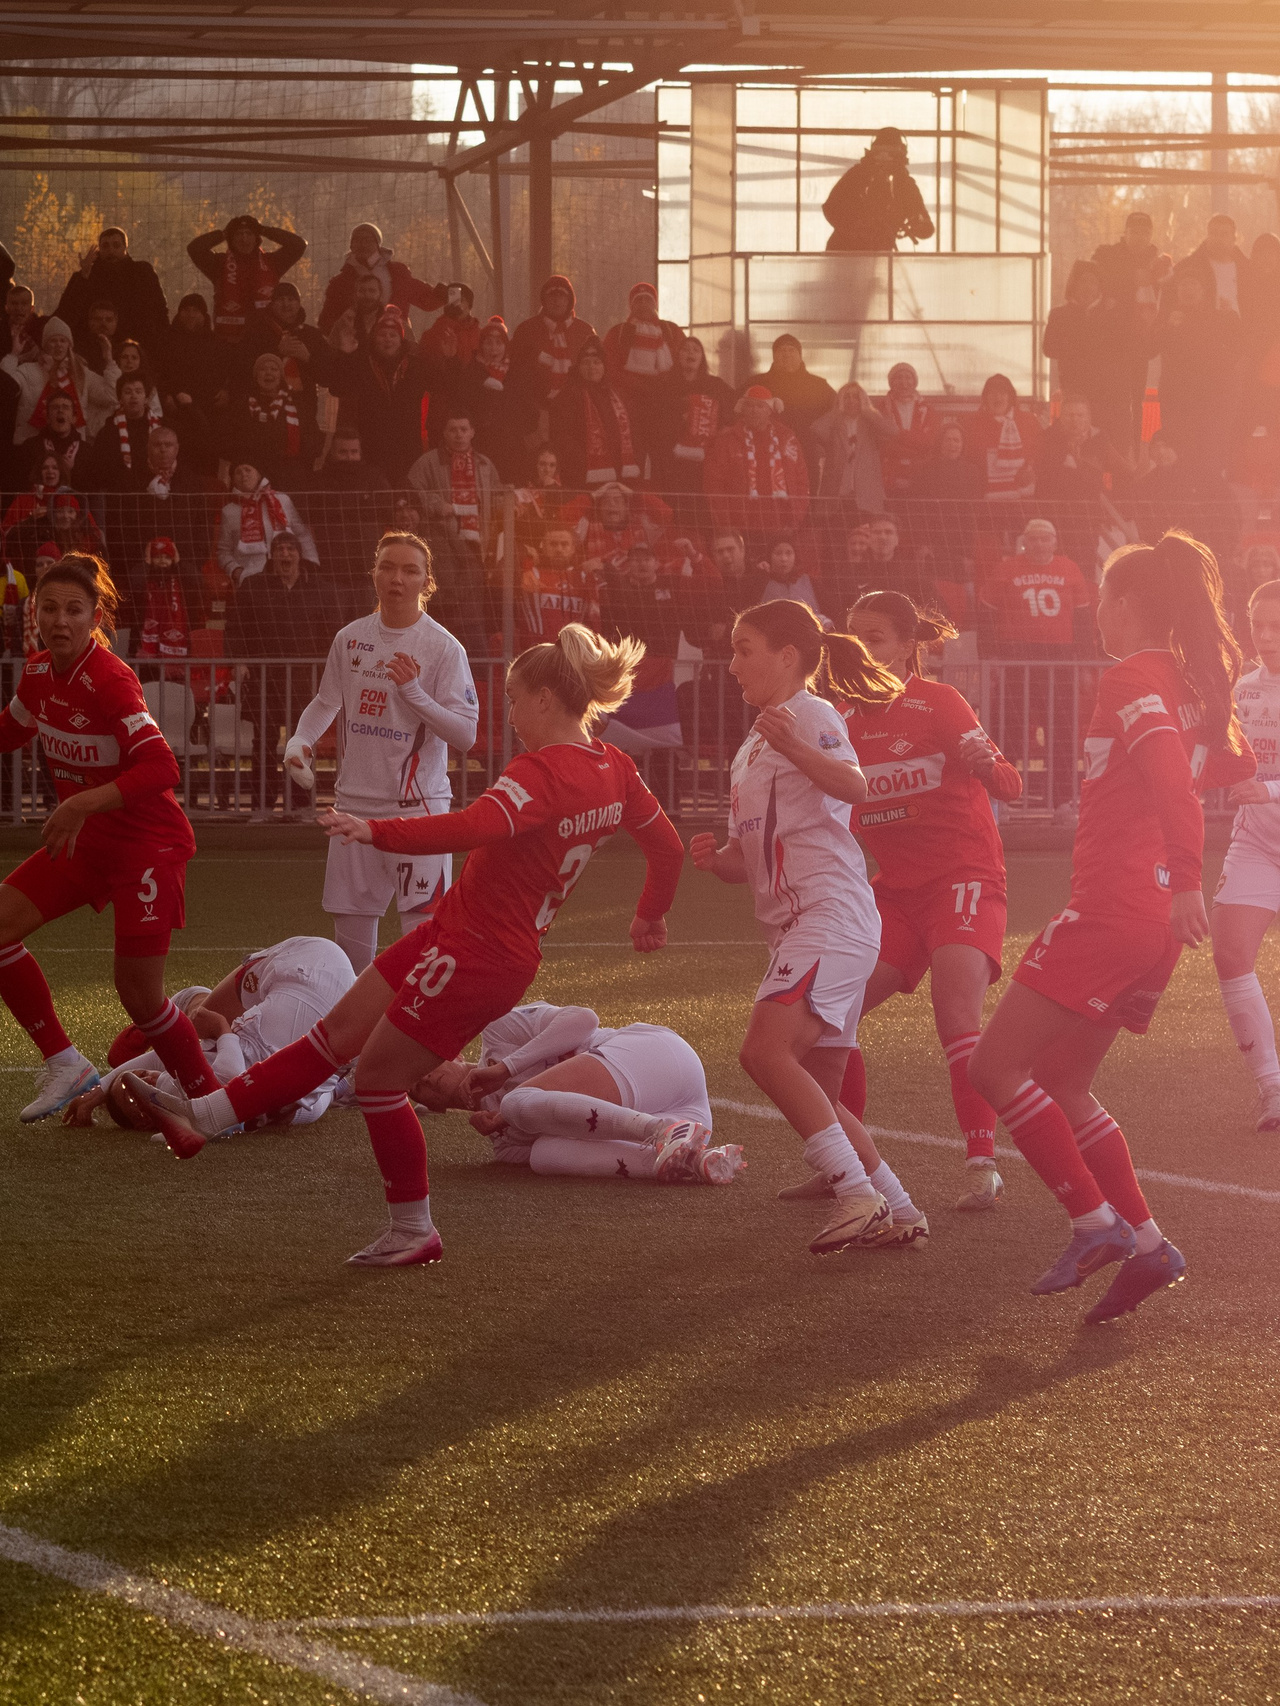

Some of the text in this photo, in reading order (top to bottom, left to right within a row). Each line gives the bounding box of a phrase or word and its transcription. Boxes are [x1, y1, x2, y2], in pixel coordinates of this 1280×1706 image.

[1023, 587, 1061, 617] 10
[357, 642, 375, 652] ПСБ
[360, 689, 388, 704] FON
[359, 702, 387, 717] BET
[351, 722, 413, 743] самолет
[1252, 737, 1277, 751] FON
[861, 808, 906, 826] WINLINE
[396, 862, 413, 897] 17
[951, 881, 982, 916] 11
[405, 946, 456, 997] 20
